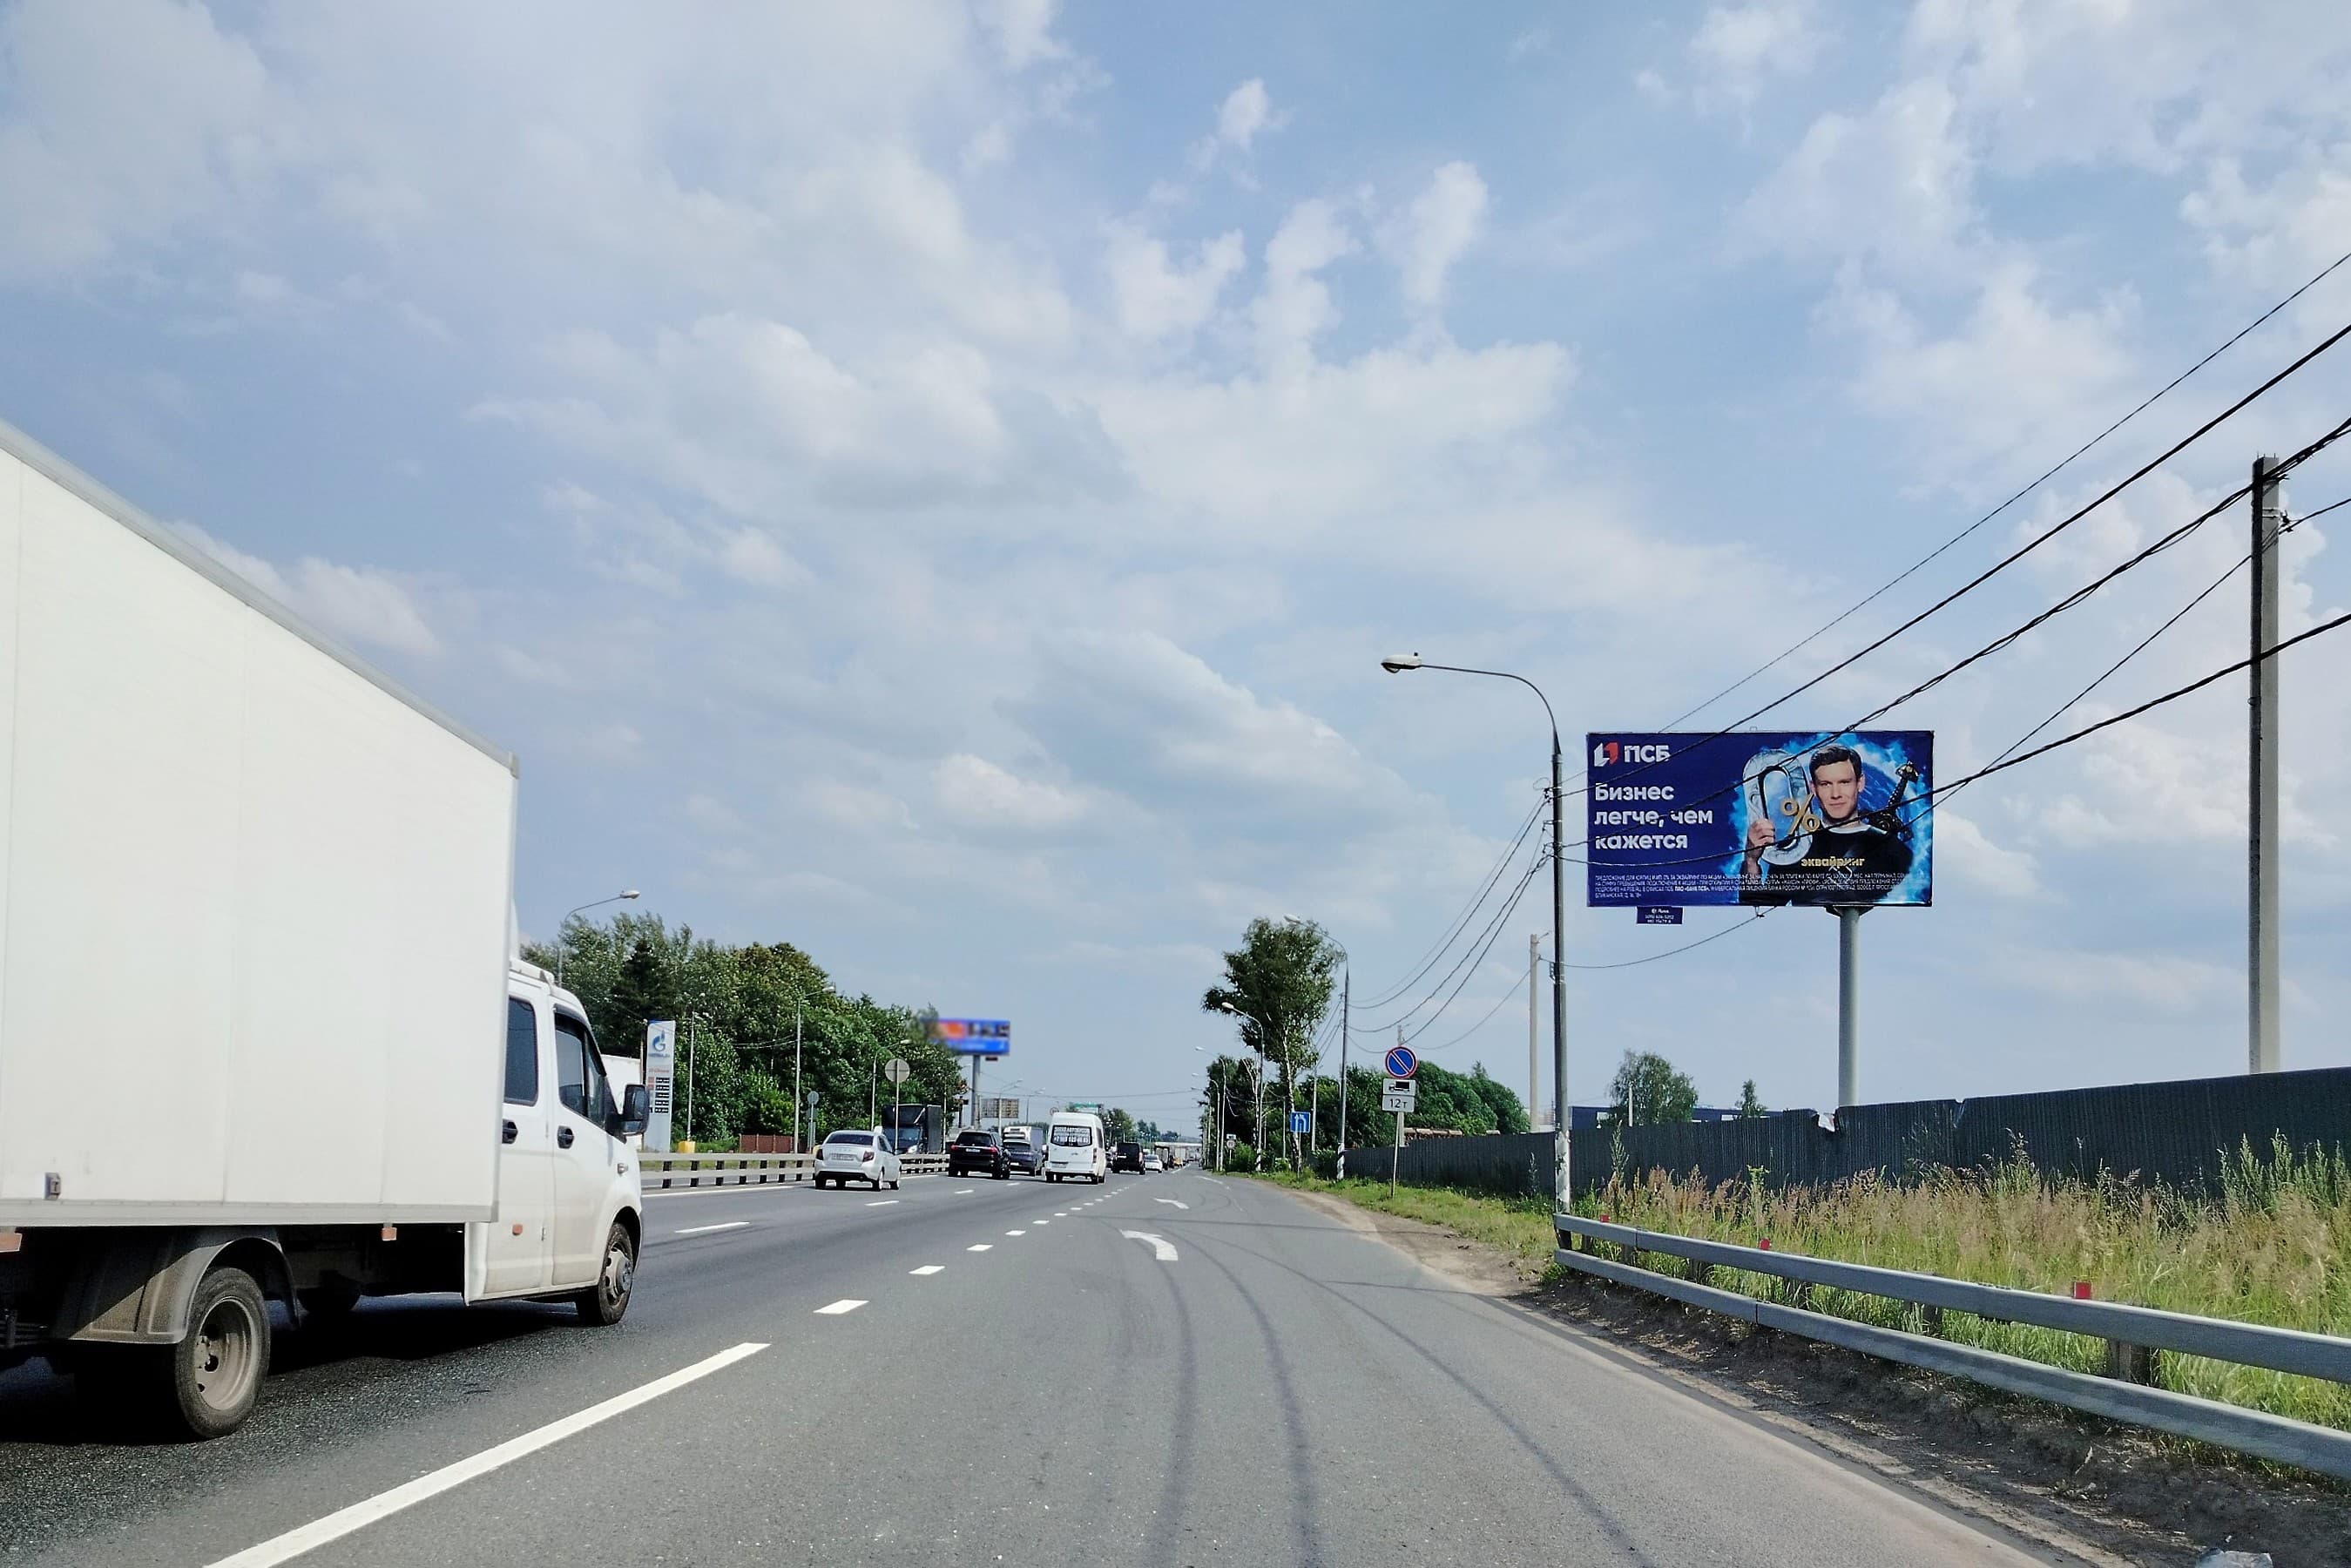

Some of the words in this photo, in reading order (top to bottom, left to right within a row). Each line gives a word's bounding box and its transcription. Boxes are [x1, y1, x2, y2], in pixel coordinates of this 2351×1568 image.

[1624, 745, 1671, 763] ПСБ
[1595, 782, 1674, 801] Бизнес
[1594, 810, 1665, 828] легче,
[1670, 810, 1713, 824] чем
[1595, 835, 1688, 849] кажется
[1800, 855, 1865, 869] эквайринг
